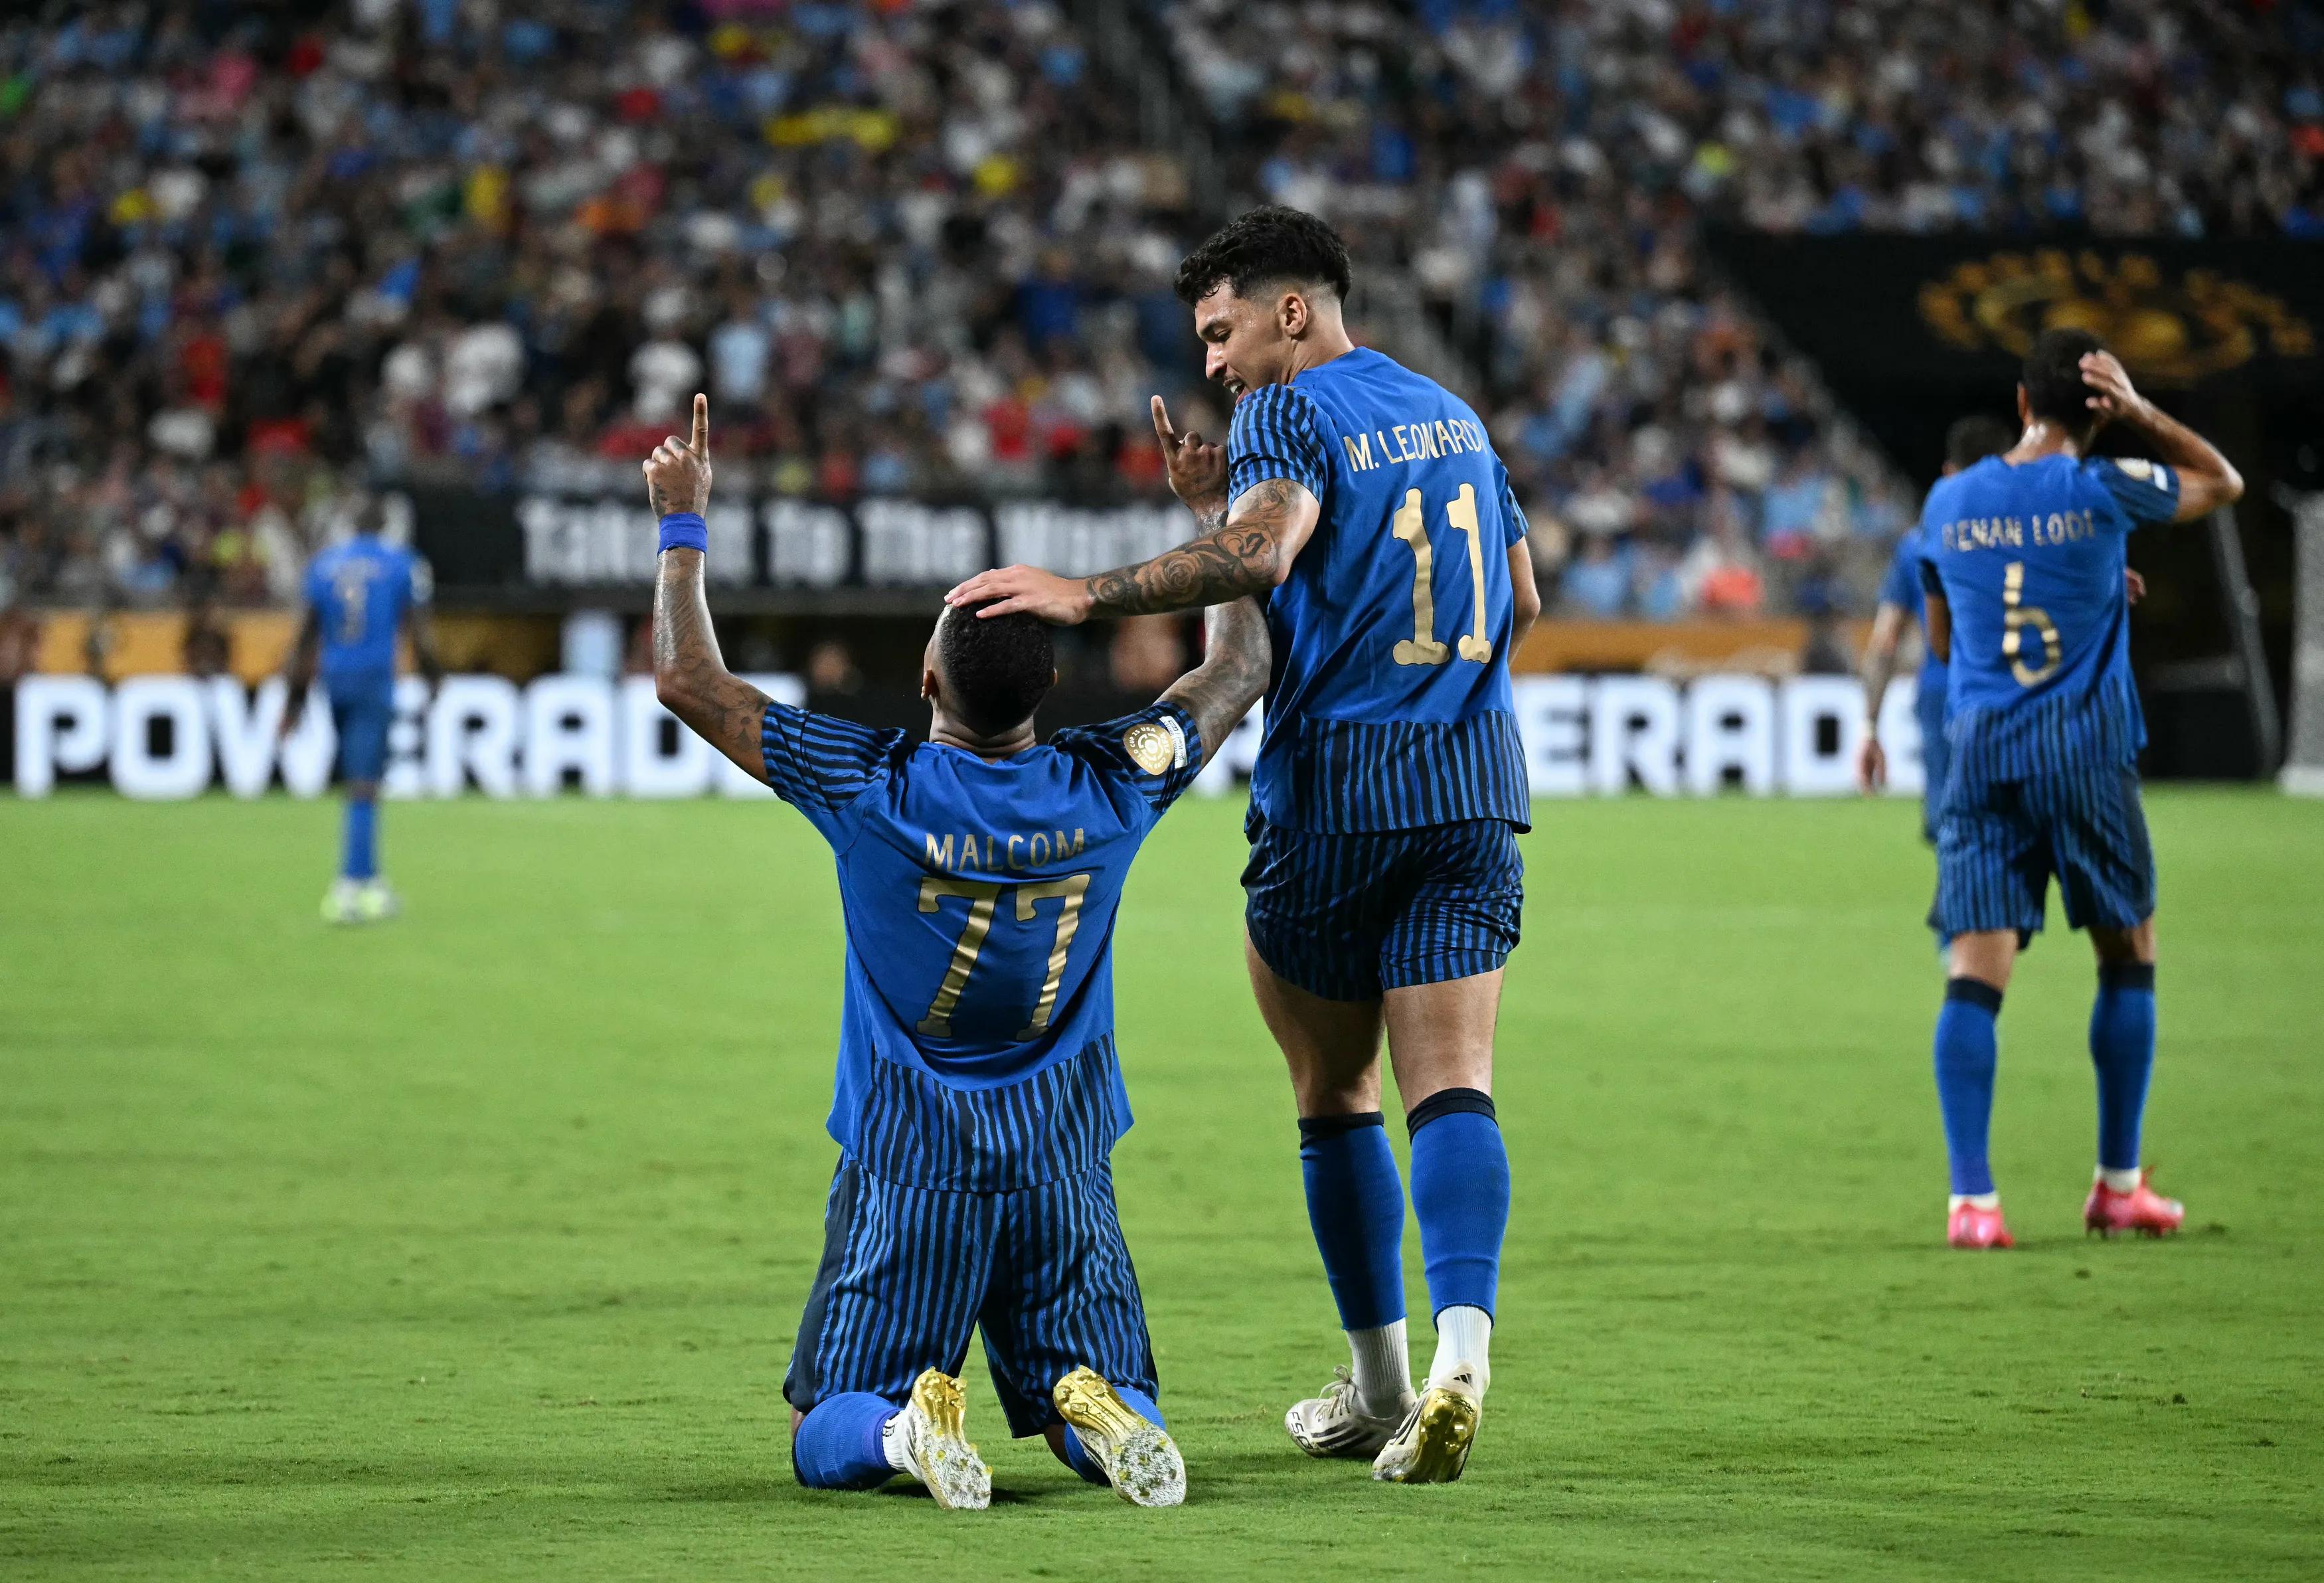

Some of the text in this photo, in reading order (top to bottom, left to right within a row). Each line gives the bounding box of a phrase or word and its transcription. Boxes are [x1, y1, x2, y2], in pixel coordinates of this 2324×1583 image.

[1343, 433, 1380, 472] M.
[2032, 507, 2096, 546] LODI
[1392, 483, 1492, 665] 11
[2003, 561, 2062, 689] 6
[924, 828, 1084, 872] MALCOM
[916, 874, 1090, 1042] 77
